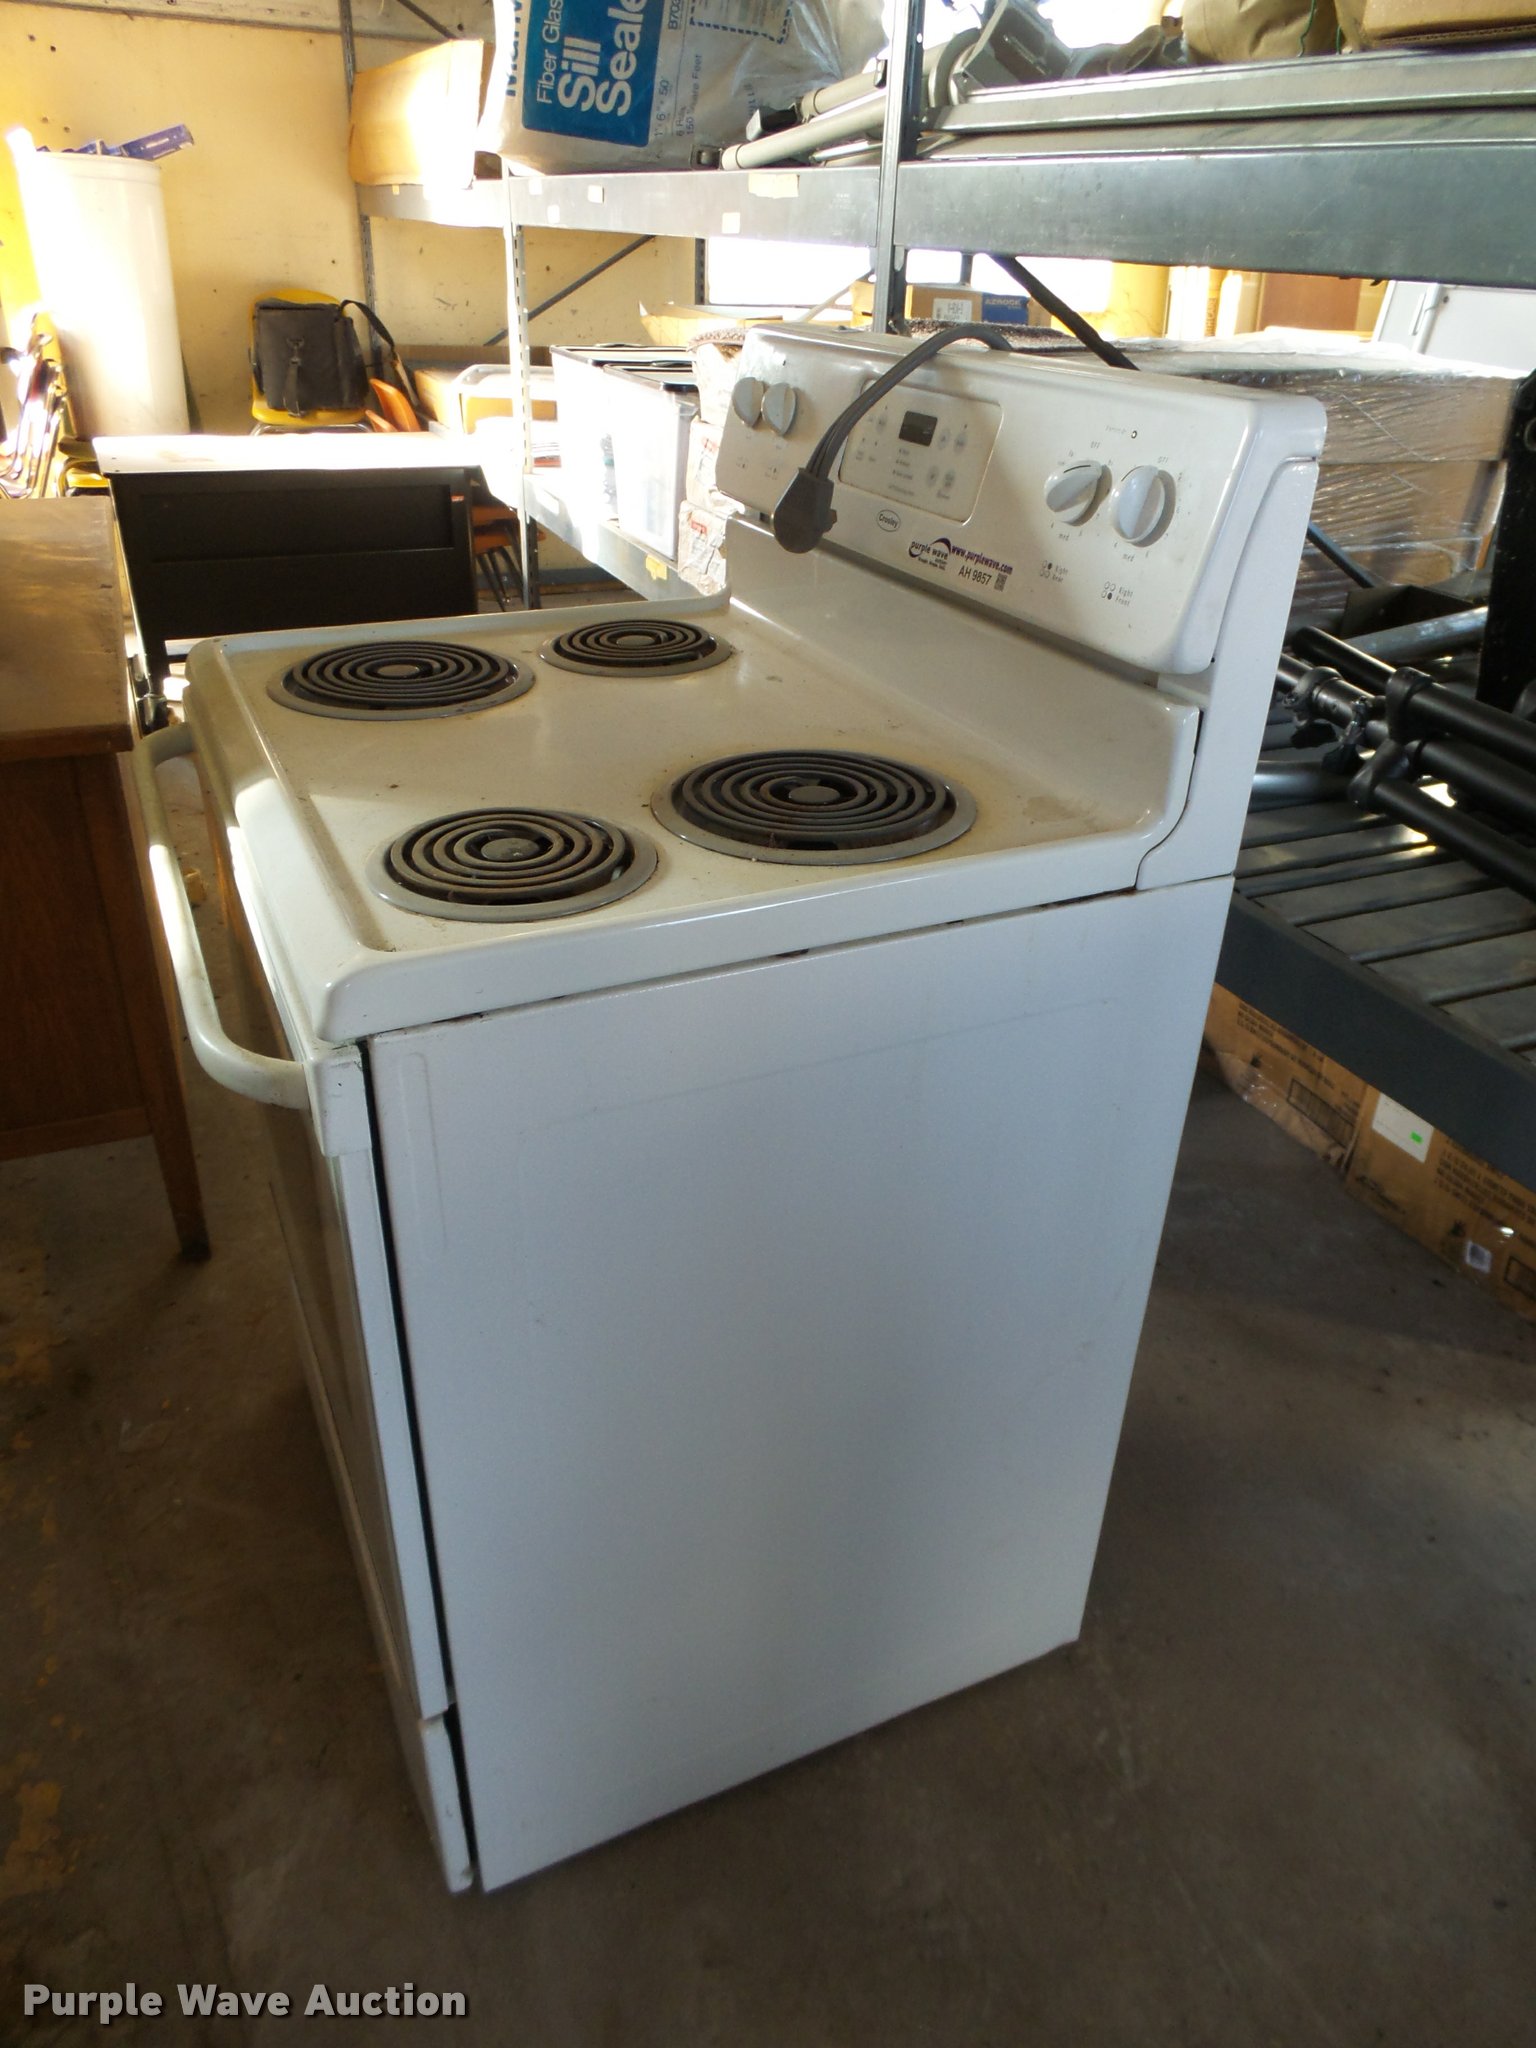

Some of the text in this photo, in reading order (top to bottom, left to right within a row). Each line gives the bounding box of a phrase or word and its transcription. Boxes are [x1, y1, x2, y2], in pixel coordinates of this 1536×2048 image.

[537, 50, 557, 104] Fiber
[557, 37, 601, 112] Sill
[911, 541, 949, 560] purple wave
[951, 544, 1013, 575] www.purplewave.com
[958, 565, 992, 586] AH 9857
